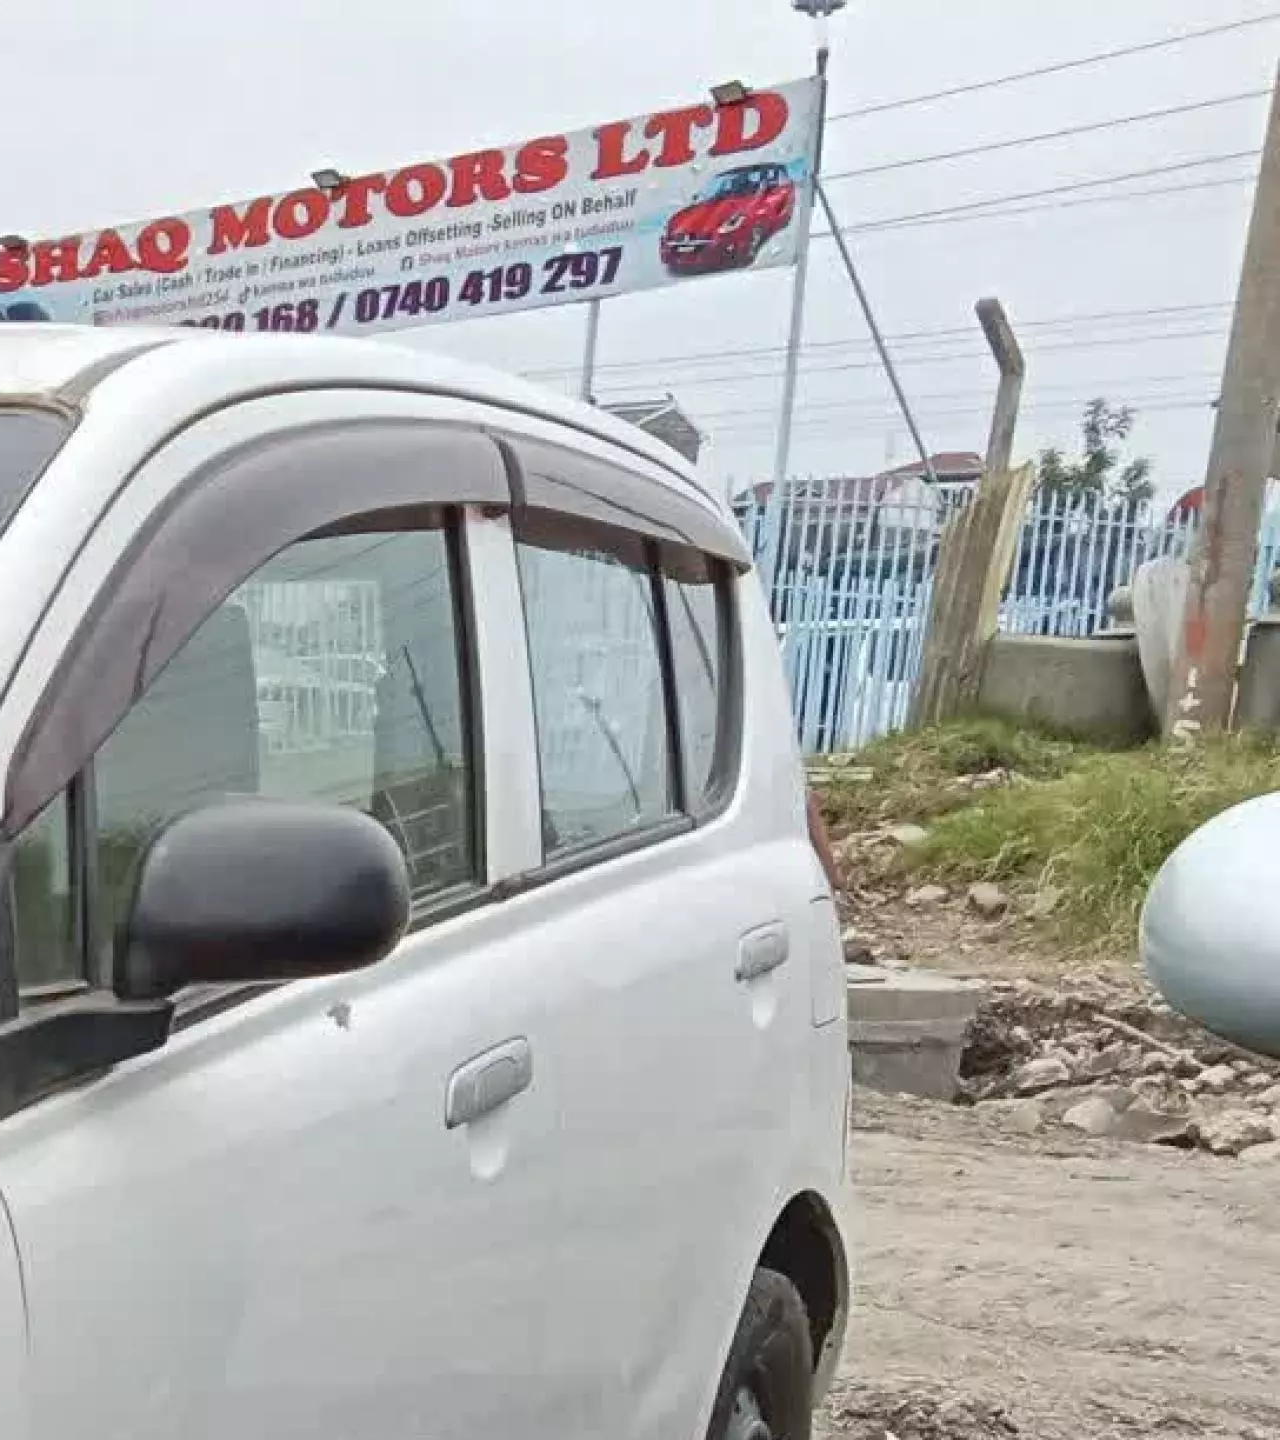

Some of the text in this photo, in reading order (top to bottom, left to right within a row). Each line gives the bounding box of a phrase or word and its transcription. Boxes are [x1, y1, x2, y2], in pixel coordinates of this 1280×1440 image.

[206, 135, 569, 256] MOTORS
[592, 91, 788, 180] LTD
[204, 264, 243, 283] Trade
[357, 234, 401, 257] Loans
[405, 220, 483, 247] Offsetting
[551, 199, 576, 221] ON
[581, 188, 638, 215] Behalf
[253, 298, 319, 332] 168
[326, 291, 348, 329] /
[355, 276, 450, 323] 0740
[458, 262, 533, 305] 419
[540, 246, 623, 294] 297
